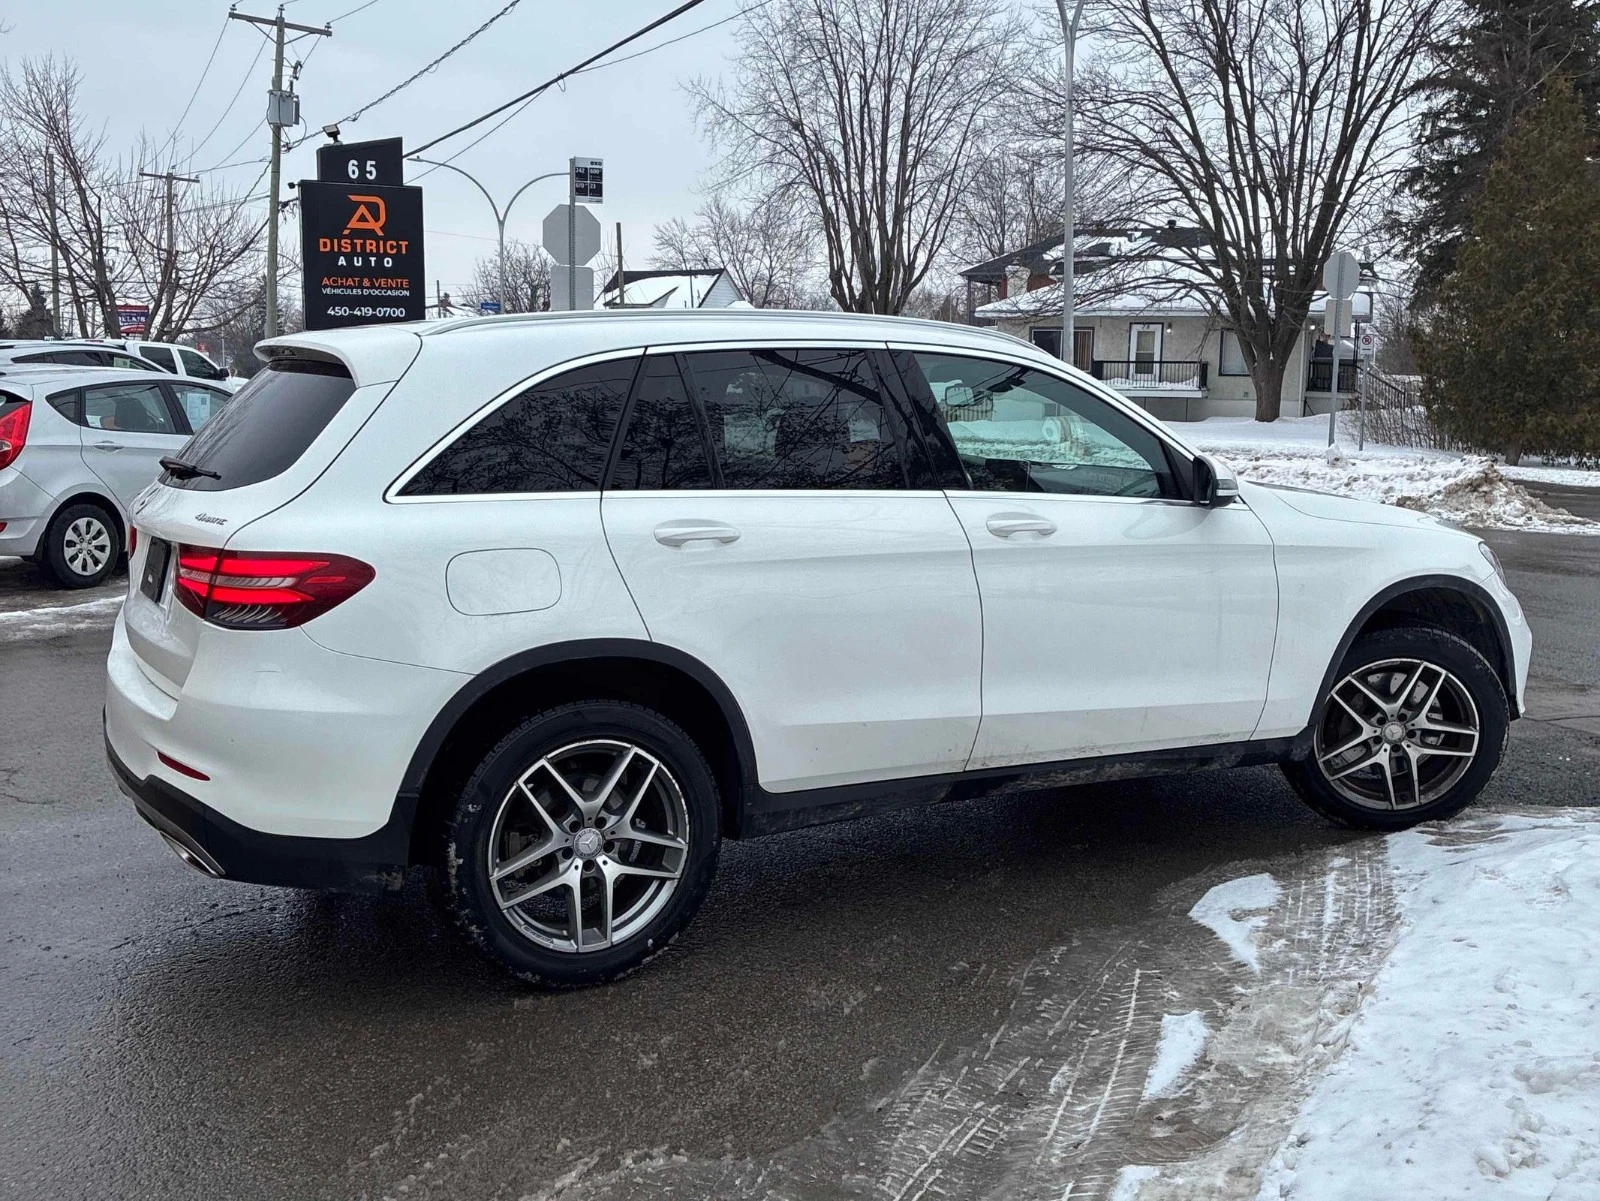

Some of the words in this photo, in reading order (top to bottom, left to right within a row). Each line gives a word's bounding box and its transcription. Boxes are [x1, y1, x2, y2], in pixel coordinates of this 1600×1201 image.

[347, 159, 377, 180] 65
[319, 238, 409, 255] DISTRICT
[337, 255, 393, 268] AUTO
[321, 276, 361, 287] ACHAT
[362, 277, 371, 287] &
[373, 278, 410, 288] VENTE
[321, 287, 362, 296] VÉHICULES
[363, 288, 410, 297] D'OCCASION
[326, 306, 406, 318] 450-419-0700
